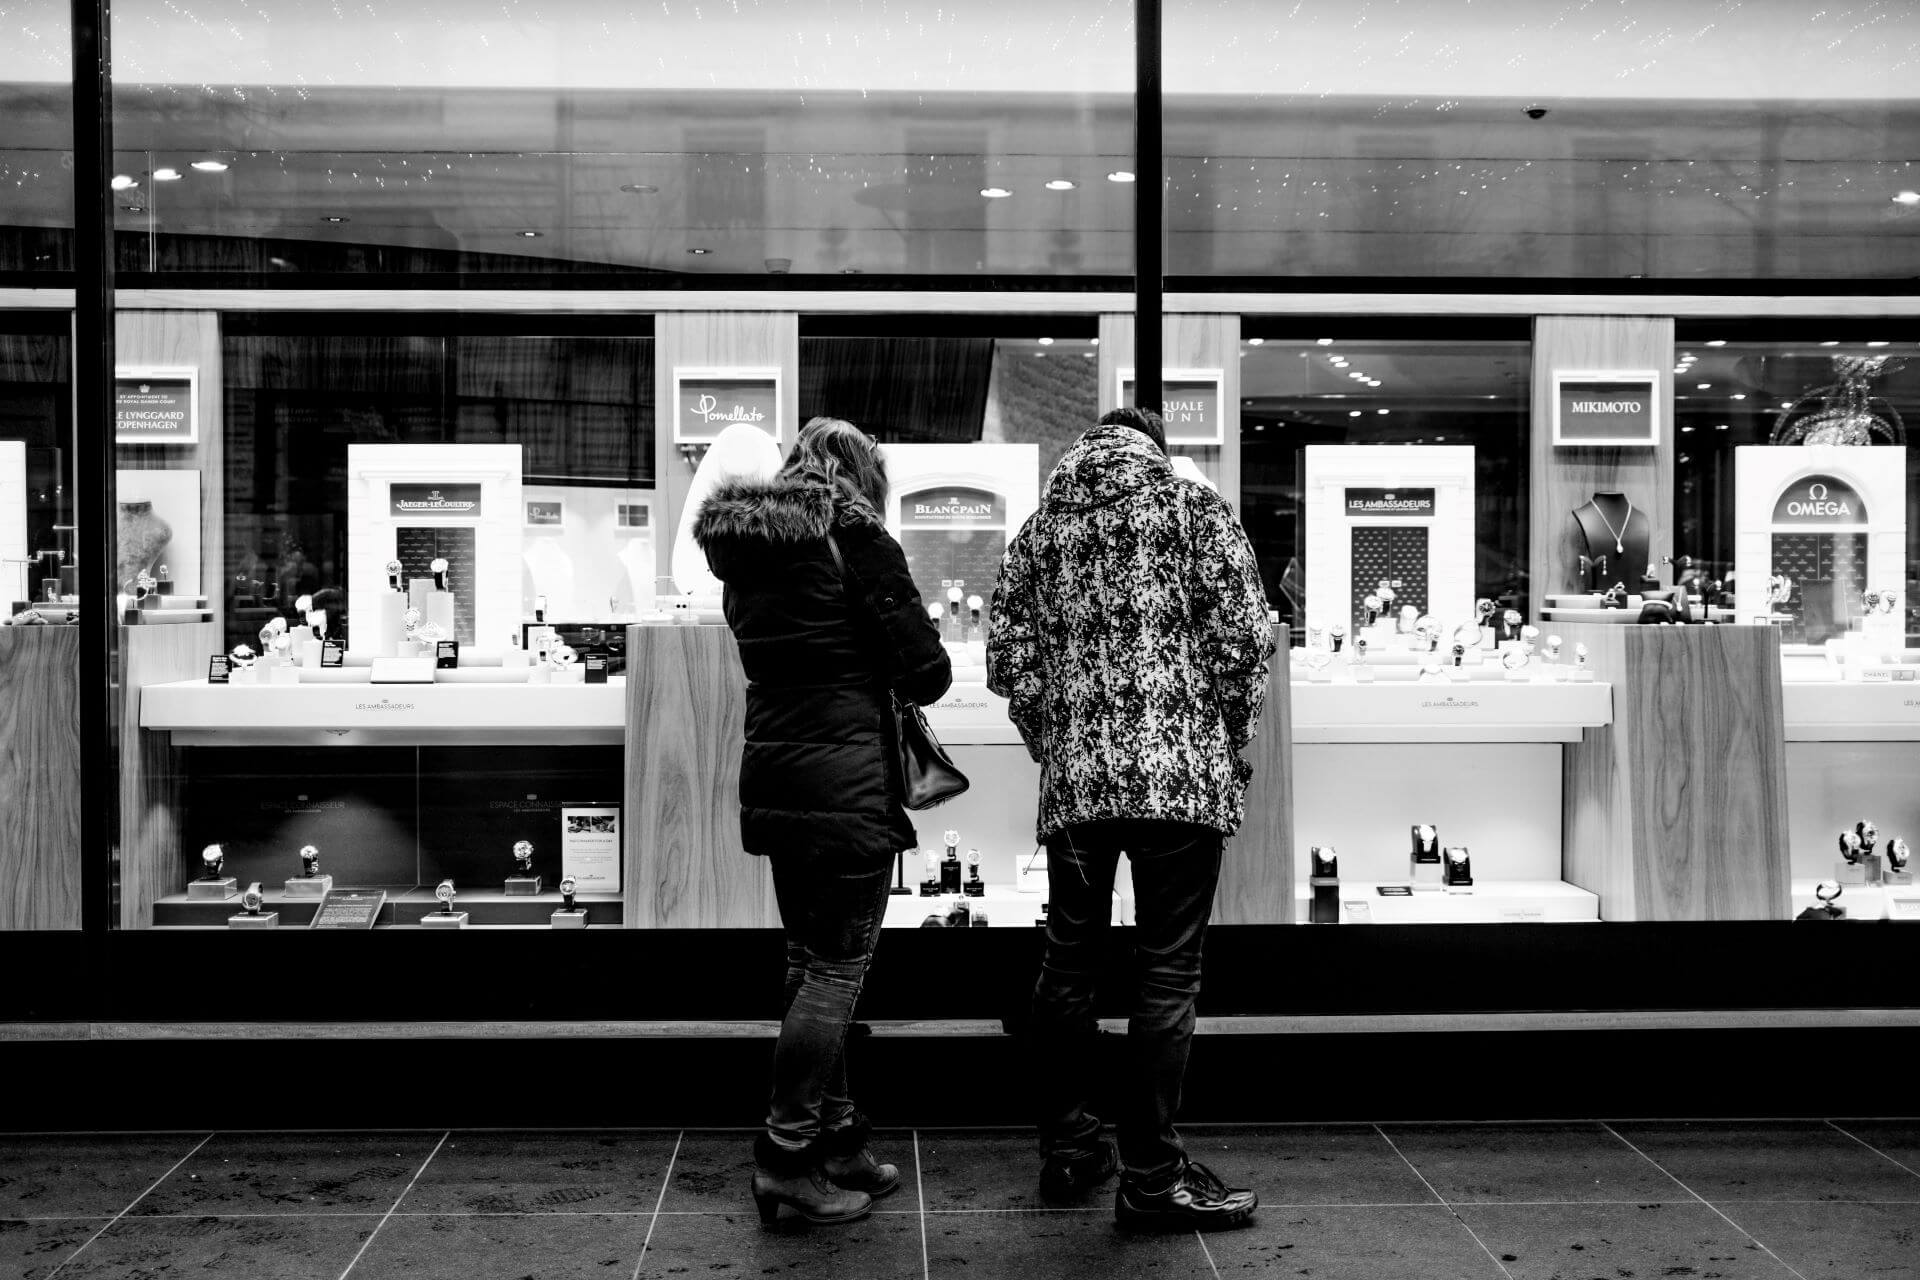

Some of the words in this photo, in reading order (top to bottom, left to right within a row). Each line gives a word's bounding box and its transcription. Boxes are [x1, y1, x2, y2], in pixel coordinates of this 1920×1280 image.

[690, 394, 766, 424] Pomellato
[1572, 401, 1641, 413] MIKIMOTO
[125, 411, 185, 420] LYNGGAARD
[116, 421, 178, 429] OPENHAGEN
[1349, 500, 1364, 508] LES
[1365, 500, 1431, 508] AMBASSADEURS
[1787, 501, 1851, 516] OMEGA
[914, 504, 992, 514] BLANCPAIN
[489, 801, 517, 809] ESPACE
